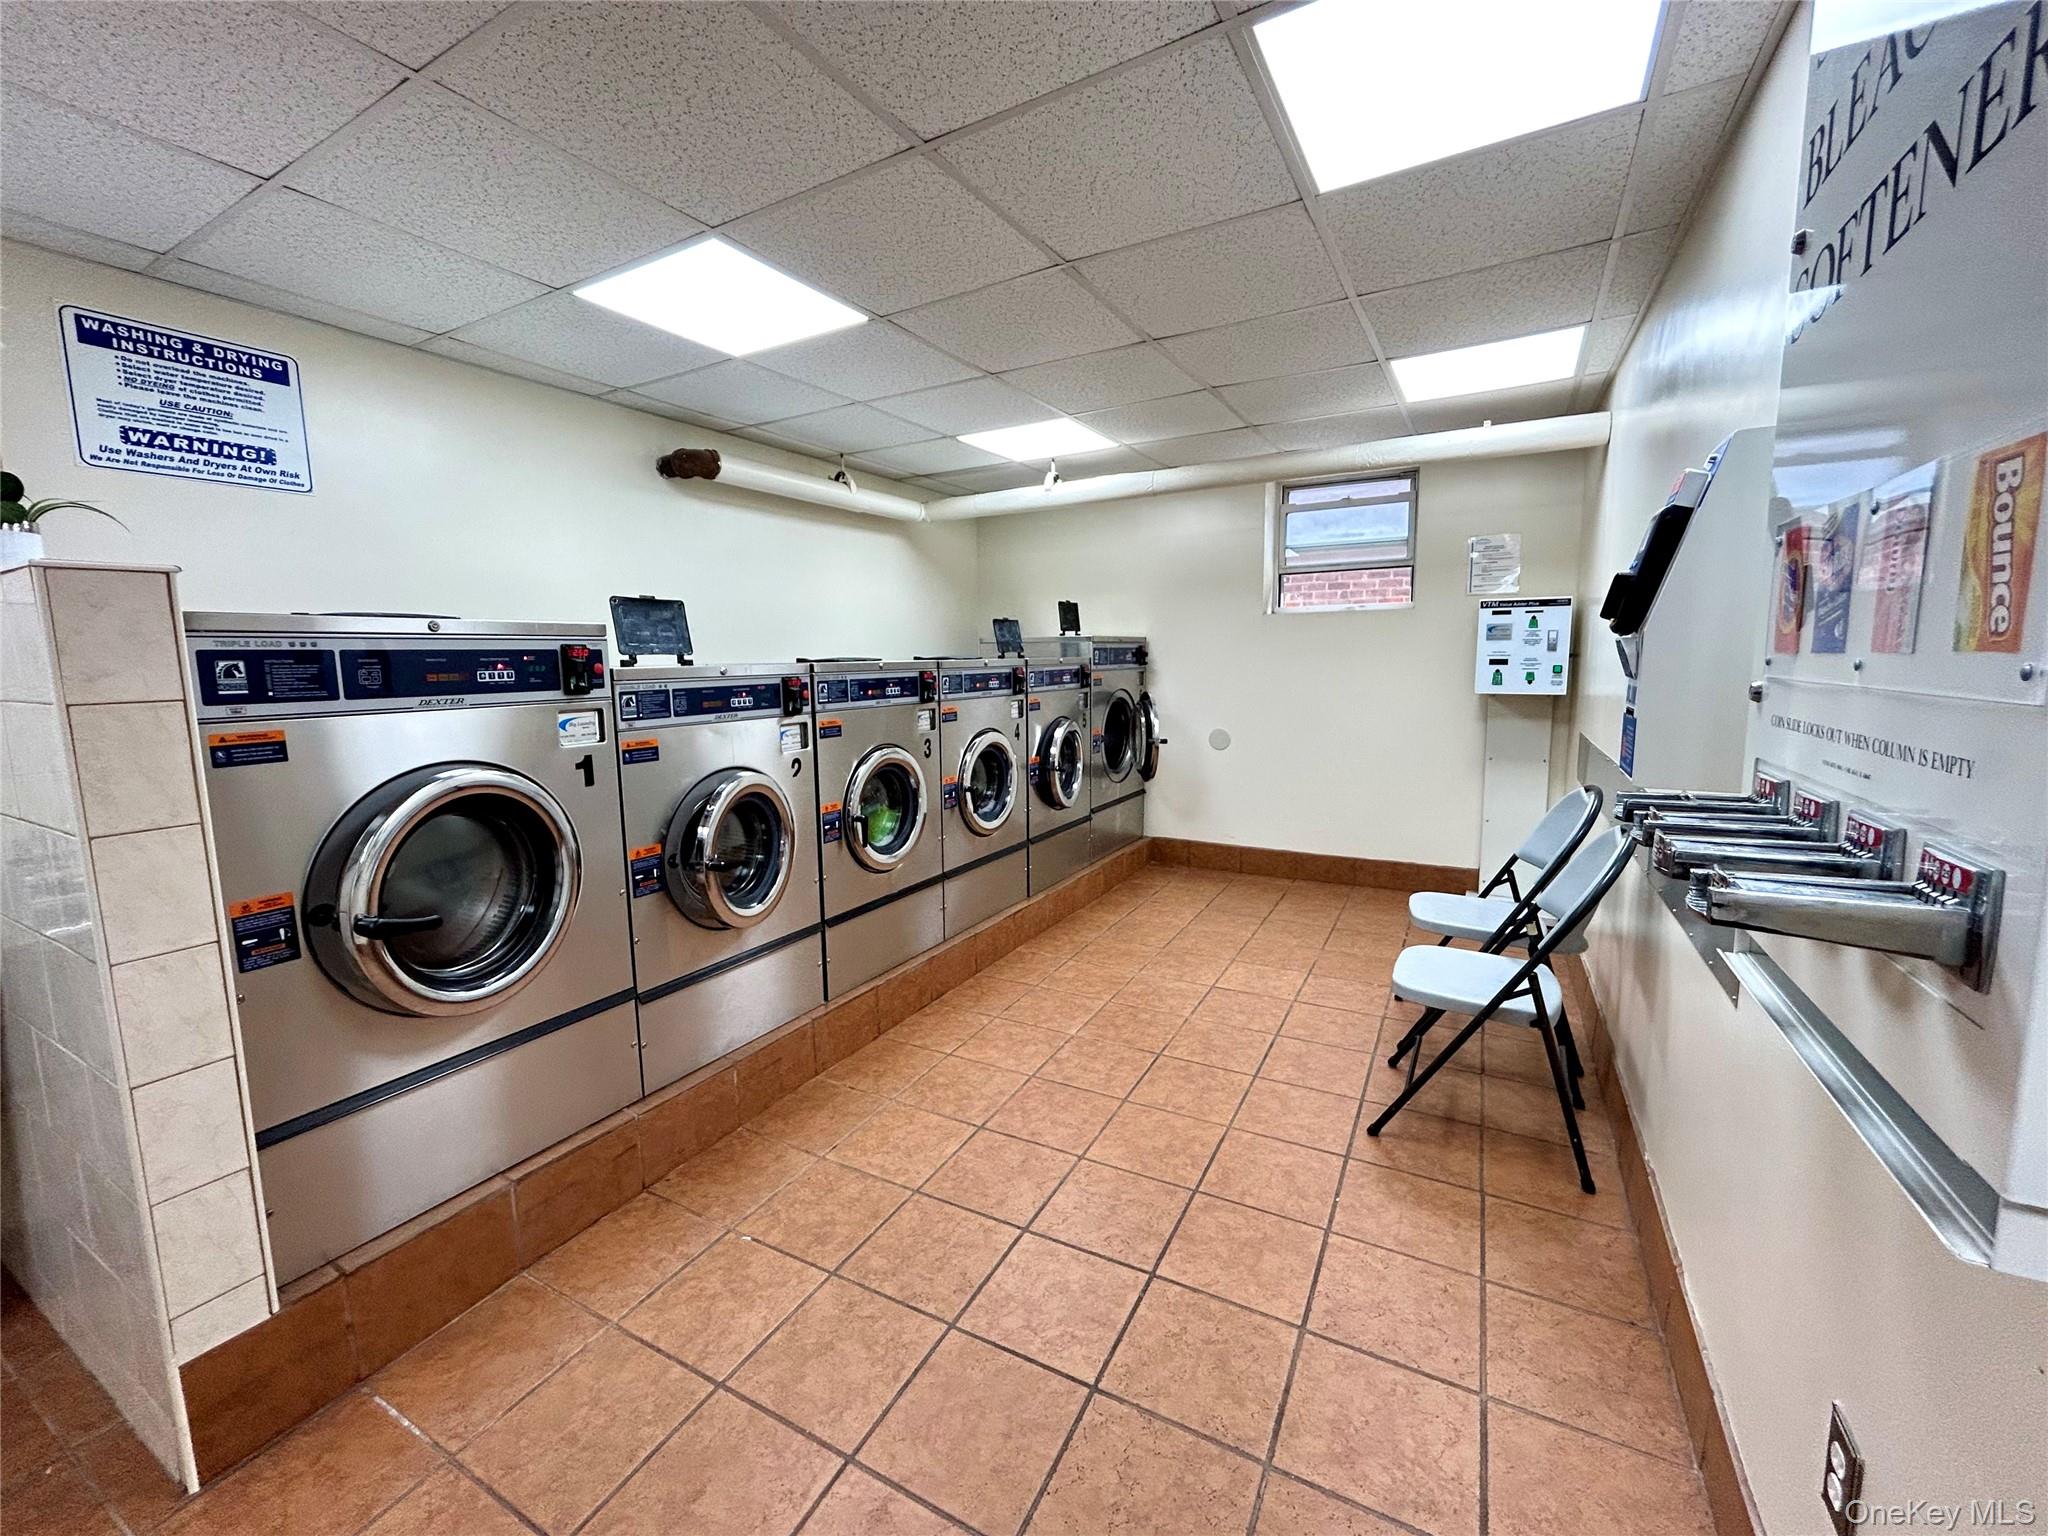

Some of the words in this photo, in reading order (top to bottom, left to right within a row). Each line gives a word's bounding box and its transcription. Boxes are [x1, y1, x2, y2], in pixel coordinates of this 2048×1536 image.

[81, 317, 183, 349] WASHING
[192, 343, 205, 354] &
[213, 347, 283, 371] DRYING
[112, 337, 263, 379] INSTRUCTIONS
[124, 375, 138, 385] NO
[140, 379, 175, 391] DYEING
[189, 389, 220, 399] clothes
[159, 399, 181, 409] USE
[183, 403, 234, 419] CAUTION:
[128, 430, 266, 461] WARNING!
[90, 453, 103, 461] We
[105, 456, 121, 464] Are
[123, 459, 138, 467] Not
[141, 461, 190, 473] Responsible
[192, 467, 205, 475] For
[207, 470, 225, 478] Loss
[238, 473, 267, 484] Damage
[269, 477, 278, 485] Of
[279, 479, 305, 488] Clothes
[99, 444, 122, 456] Use
[126, 447, 175, 463] Washers
[178, 455, 200, 467] And
[203, 459, 238, 471] Dryers
[240, 464, 252, 473] At
[255, 466, 277, 477] Own
[280, 469, 300, 480] Risk
[1990, 454, 2024, 634] Bounce
[418, 697, 465, 706] DEXTER
[1014, 722, 1021, 741] 4
[1770, 714, 1785, 729] COIN
[1786, 717, 1801, 733] SLIDE
[1803, 721, 1825, 739] LOCKS
[1826, 726, 1843, 744] OUT
[1844, 730, 1871, 752] WHEN
[1872, 737, 1915, 763] COLUMN
[1918, 748, 1929, 767] IS
[1931, 751, 1976, 779] EMPTY
[923, 738, 932, 759] 3
[575, 754, 595, 788] 1
[791, 757, 802, 778] 2
